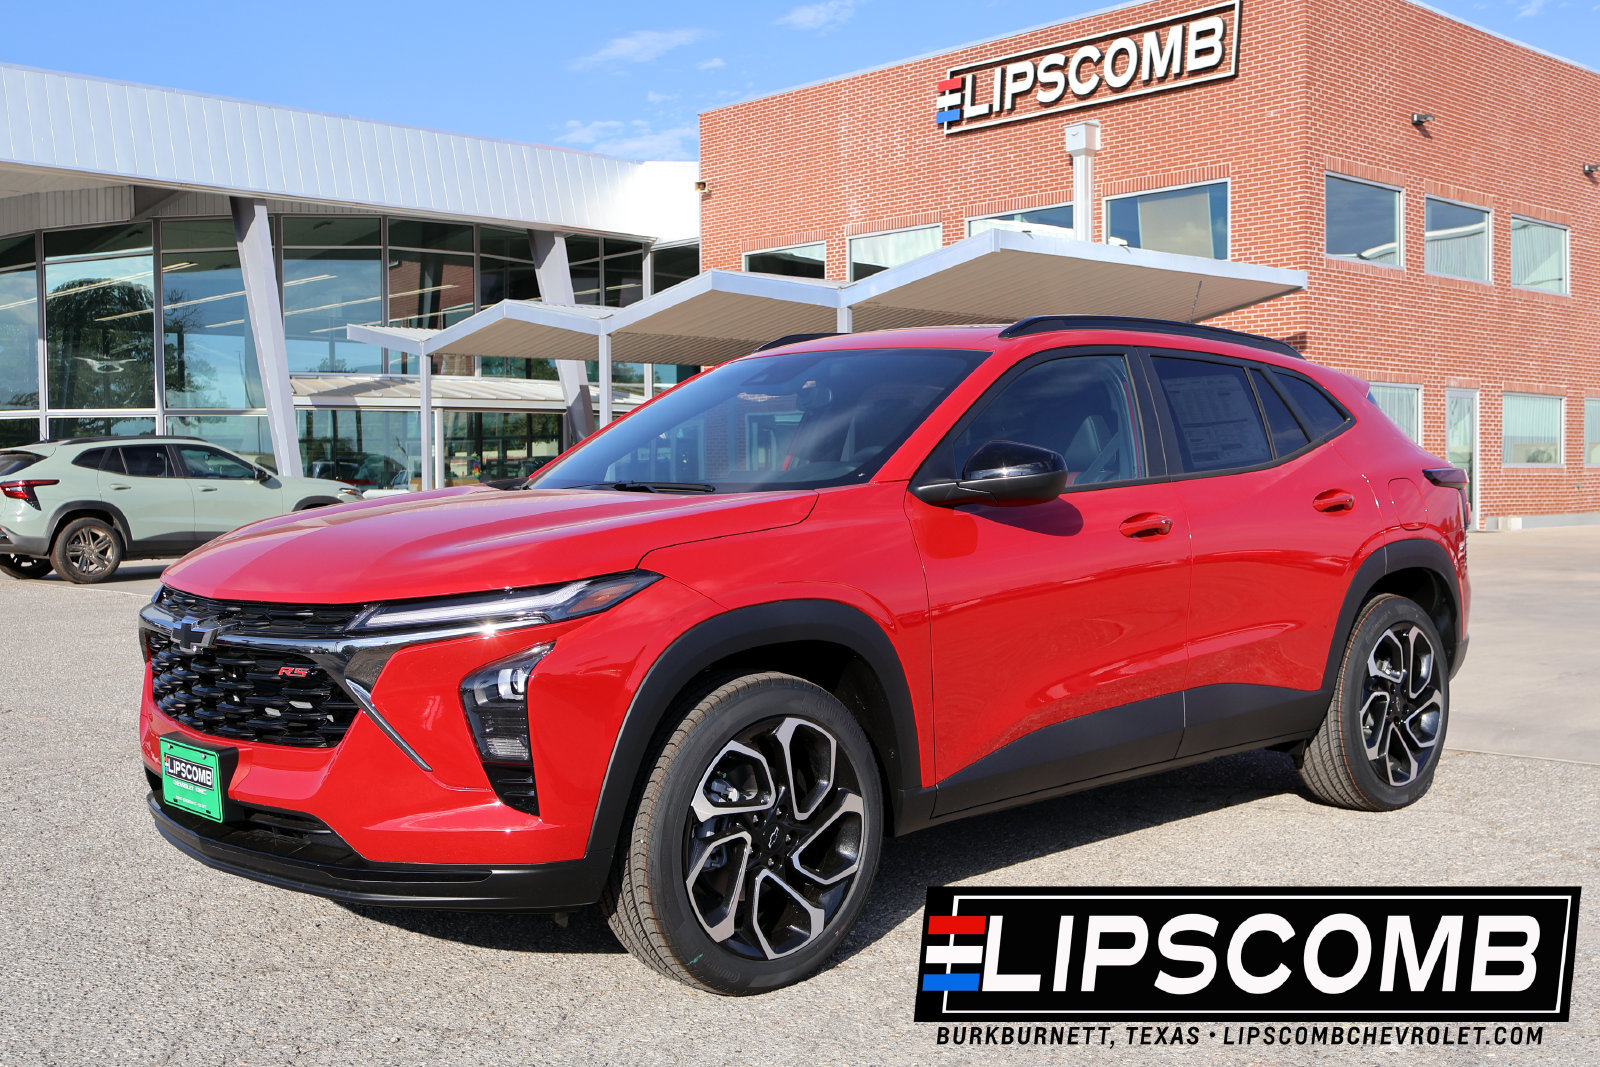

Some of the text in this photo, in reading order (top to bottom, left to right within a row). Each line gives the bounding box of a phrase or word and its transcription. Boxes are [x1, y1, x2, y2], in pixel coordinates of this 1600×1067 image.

[963, 15, 1226, 119] LIPSCOMB
[278, 666, 309, 677] RS
[167, 756, 213, 786] LIPSCOMB
